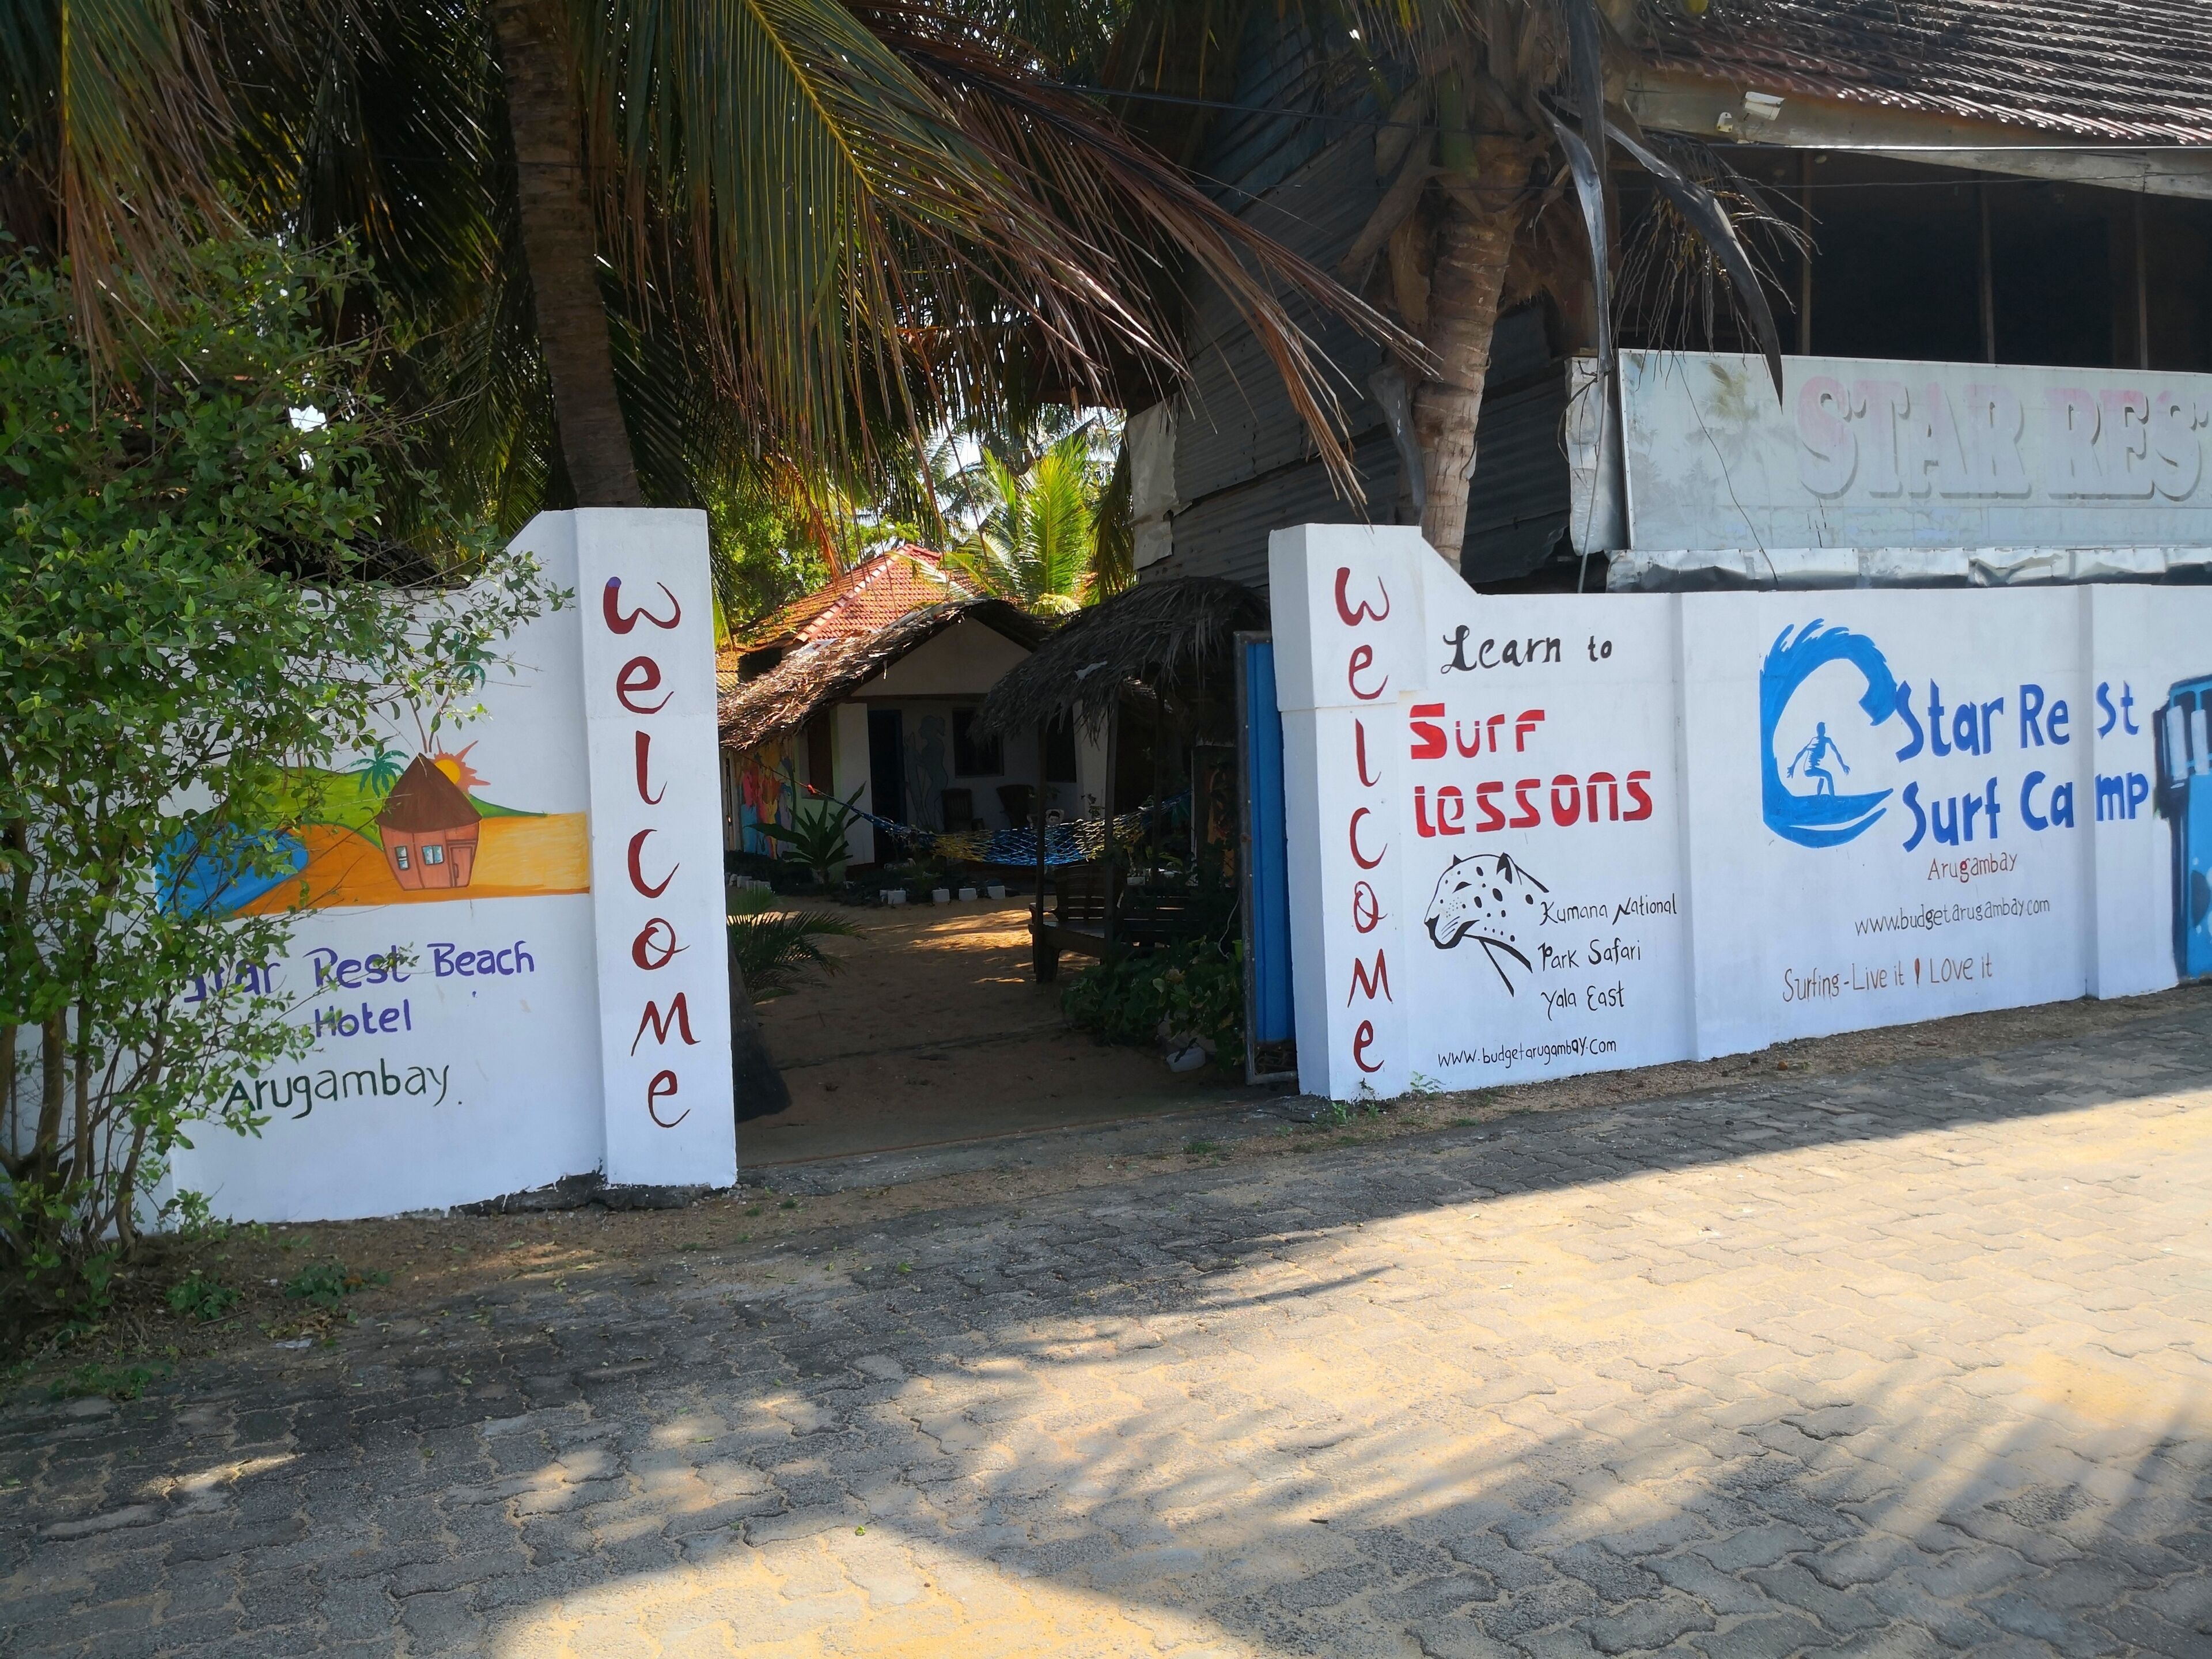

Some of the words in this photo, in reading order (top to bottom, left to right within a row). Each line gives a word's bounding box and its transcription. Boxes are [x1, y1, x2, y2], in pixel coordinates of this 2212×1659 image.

[1797, 376, 2032, 500] STAR
[1440, 624, 1561, 674] Learn
[1587, 635, 1612, 662] to
[1895, 678, 2004, 763] Star
[1902, 777, 2001, 853] Surf
[1927, 852, 2018, 883] Arugambay
[1539, 901, 1608, 926] Kumana
[1612, 893, 1677, 926] National
[303, 945, 411, 989] Rest
[427, 940, 535, 978] Beach
[1537, 941, 1580, 972] Park
[1588, 937, 1641, 965] Safari
[314, 998, 412, 1037] Hotel
[1540, 987, 1577, 1021] Yala
[1586, 980, 1624, 1011] East
